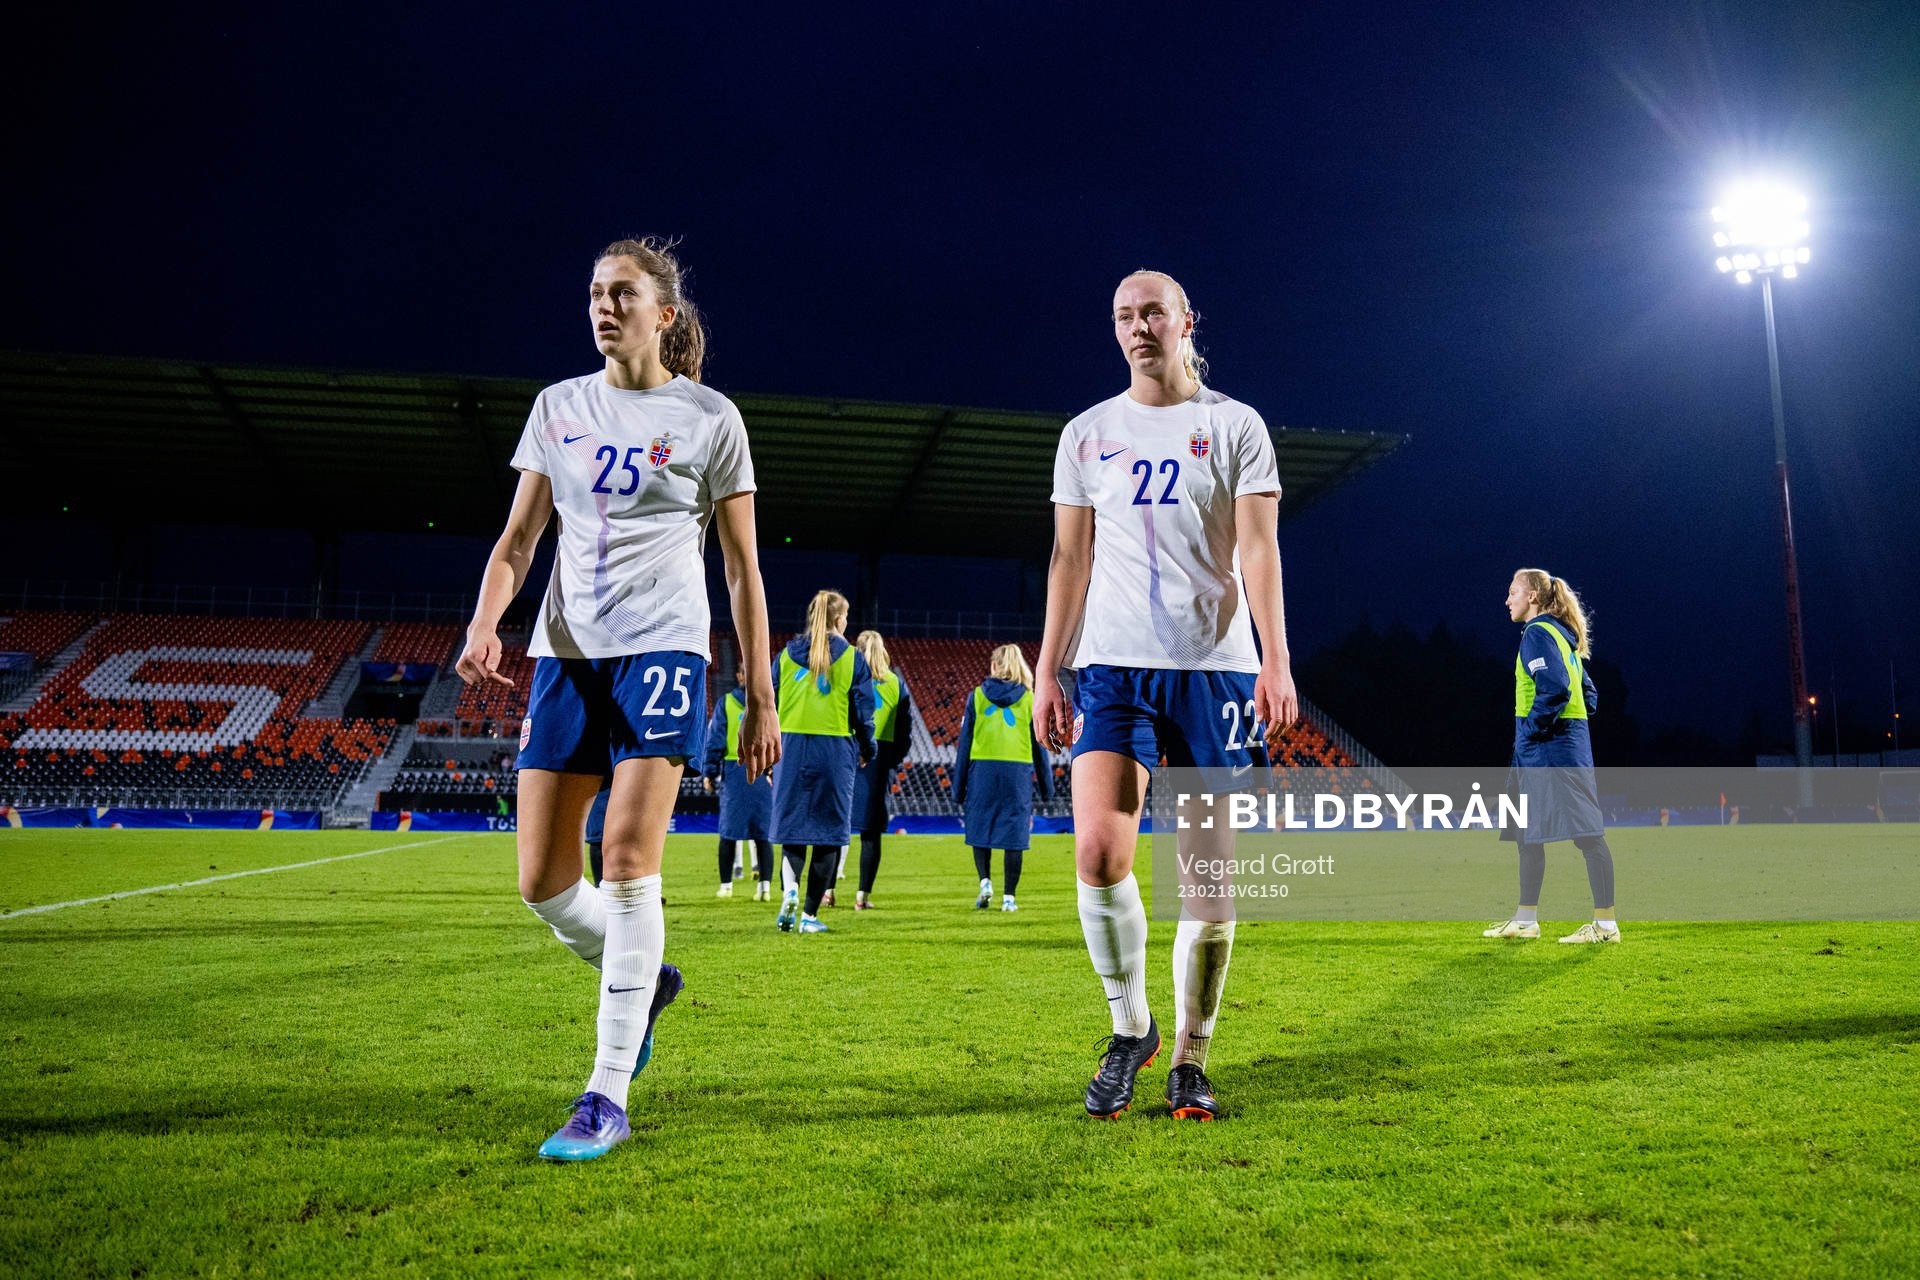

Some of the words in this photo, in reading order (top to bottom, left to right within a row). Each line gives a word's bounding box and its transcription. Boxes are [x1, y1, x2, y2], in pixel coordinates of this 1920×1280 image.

[591, 444, 644, 496] 25
[1131, 458, 1180, 505] 22
[641, 665, 691, 717] 25
[1222, 699, 1263, 751] 22
